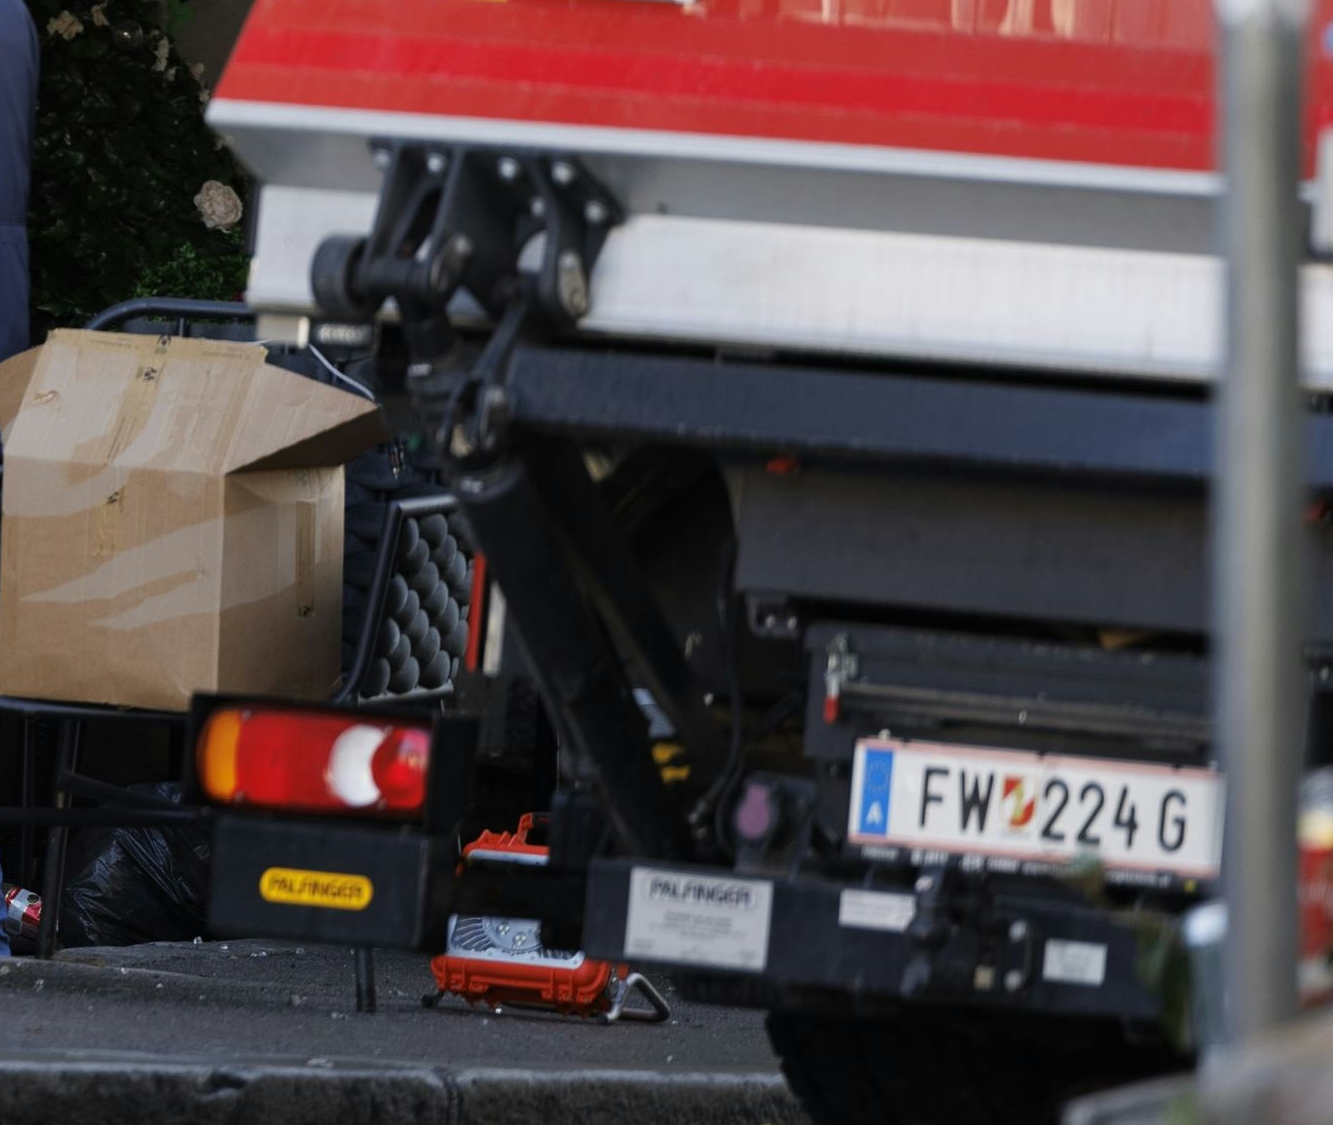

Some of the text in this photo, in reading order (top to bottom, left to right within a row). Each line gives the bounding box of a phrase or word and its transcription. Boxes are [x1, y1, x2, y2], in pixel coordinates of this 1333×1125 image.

[866, 800, 884, 826] A
[918, 766, 995, 834] FW
[269, 875, 362, 901] PALFINGER
[649, 878, 753, 907] PALFINGER
